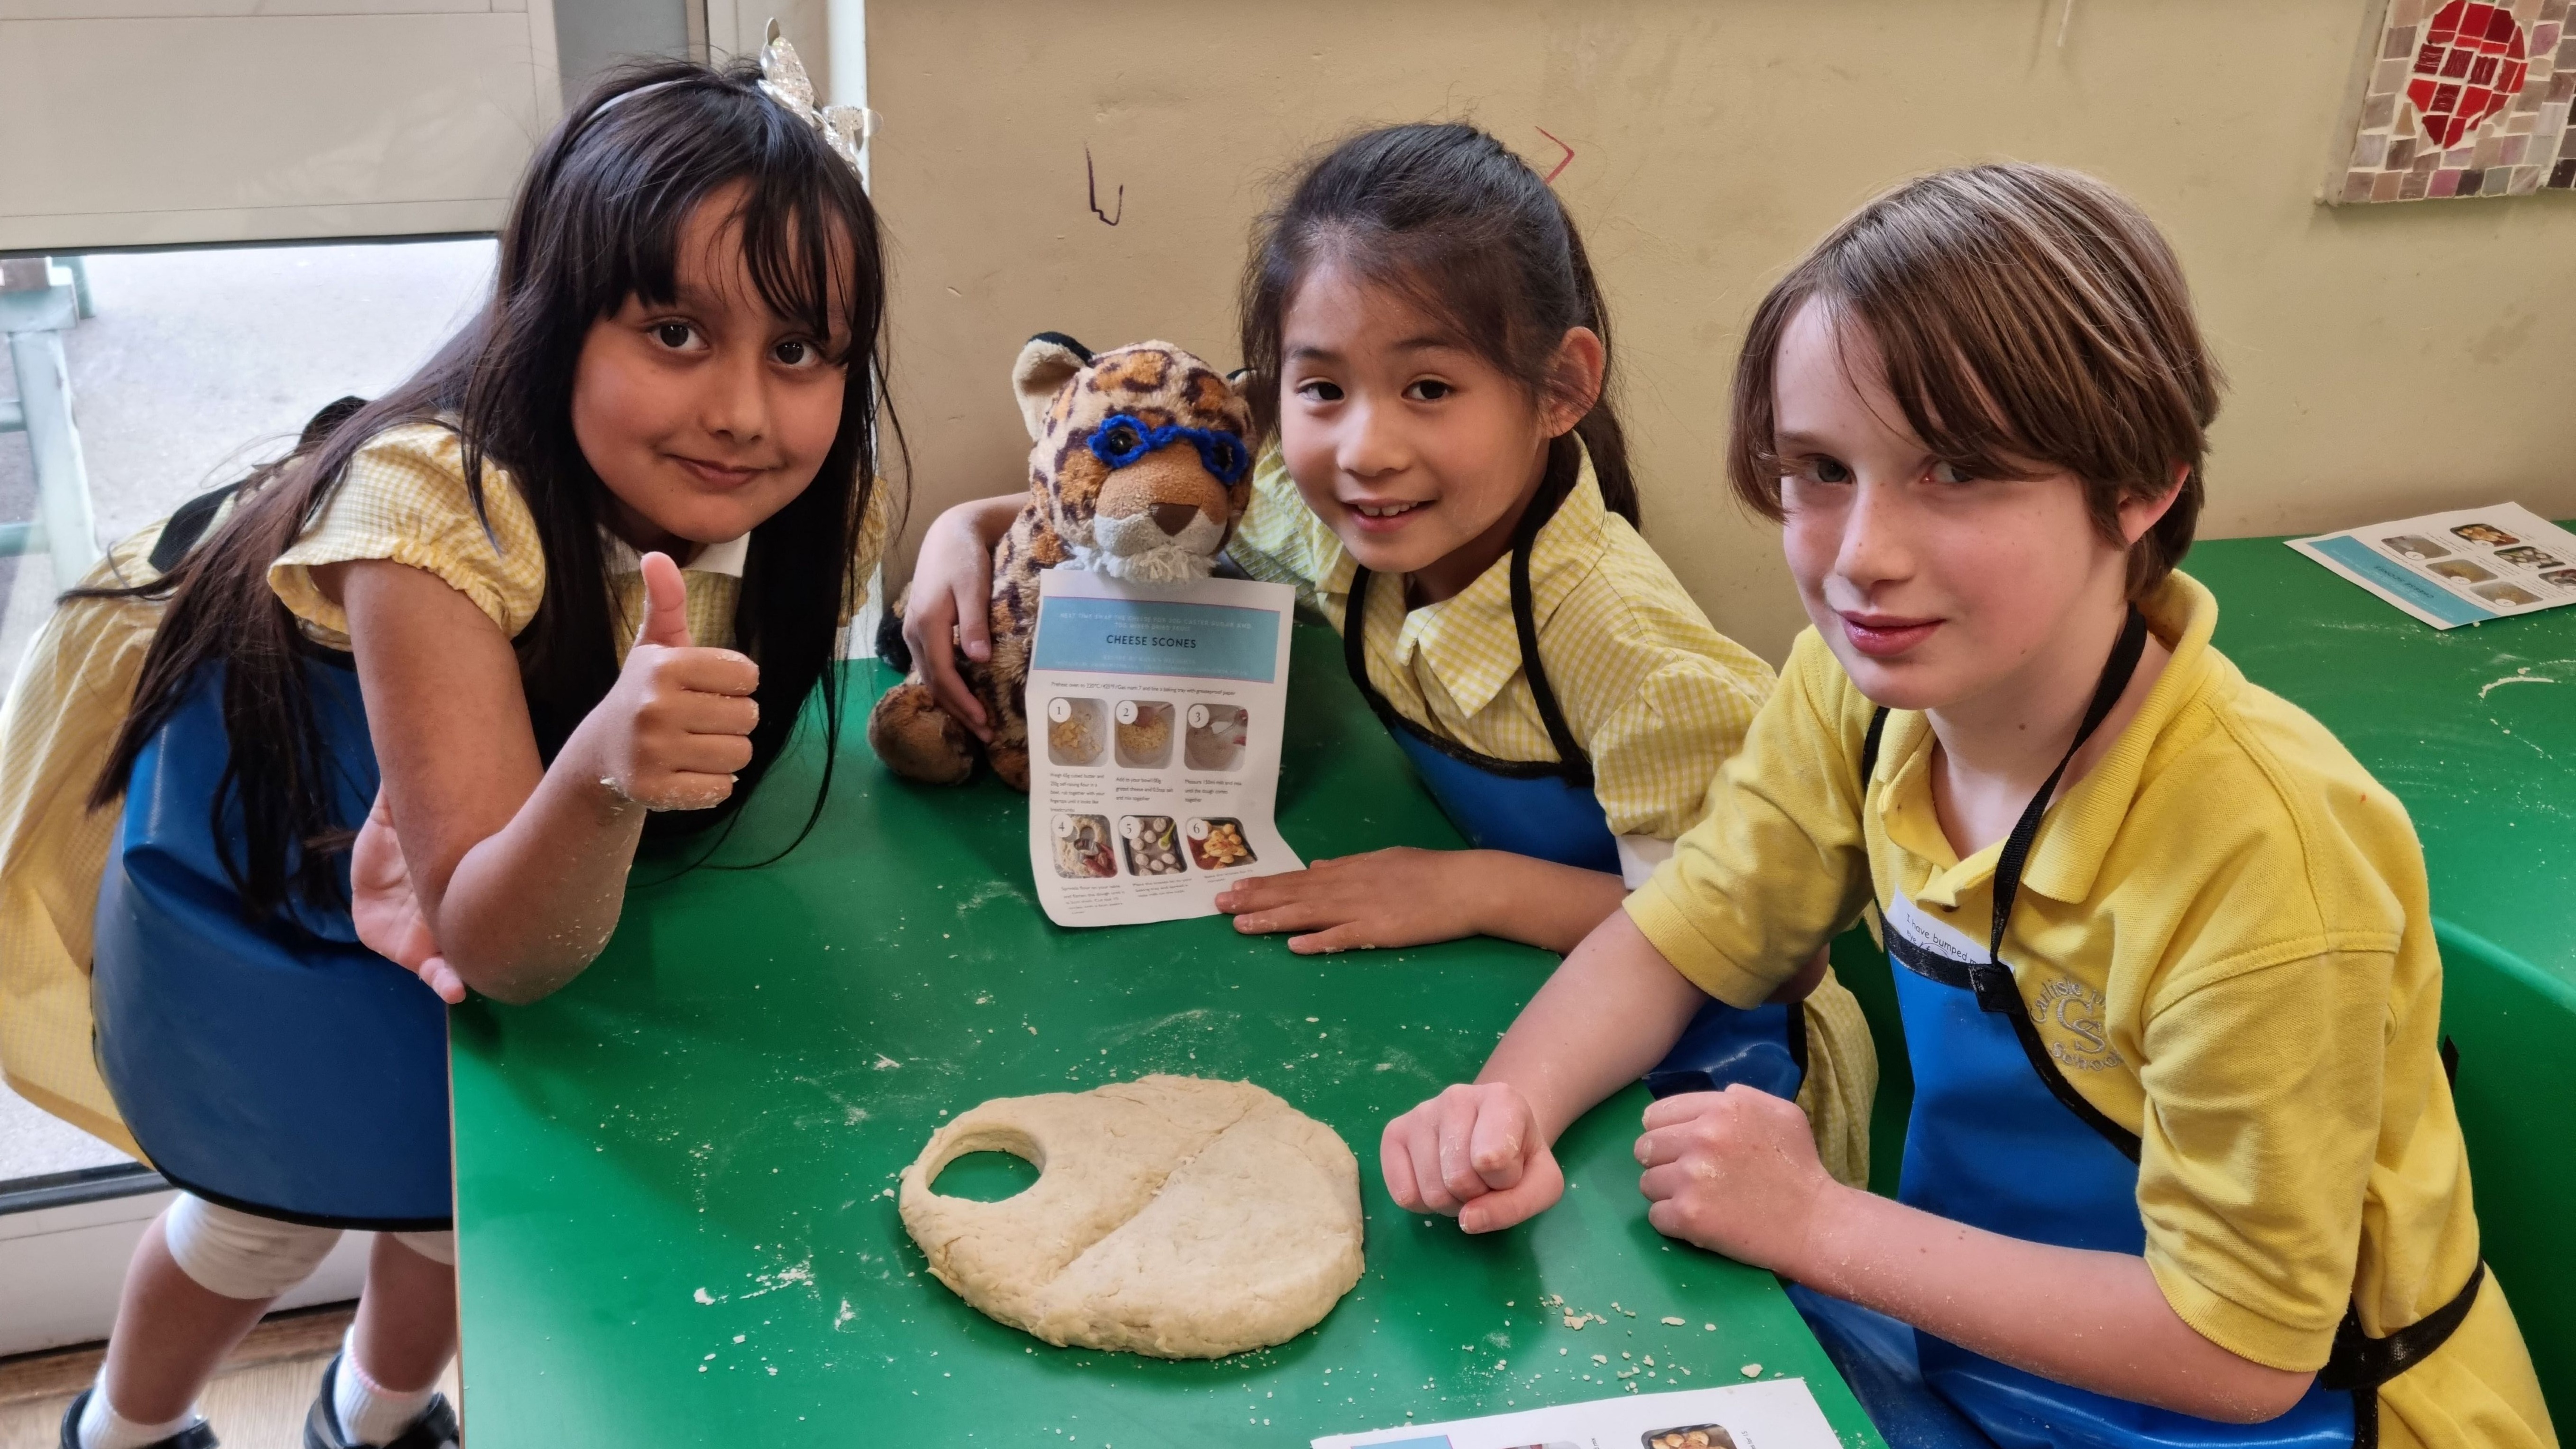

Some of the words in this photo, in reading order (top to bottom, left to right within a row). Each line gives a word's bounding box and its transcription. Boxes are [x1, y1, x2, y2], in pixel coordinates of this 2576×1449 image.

[1106, 635, 1147, 646] CHEESE
[1152, 637, 1197, 648] SCONES
[1057, 707, 1062, 715] 1
[1123, 708, 1129, 717] 2
[1195, 712, 1201, 723] 3
[1058, 821, 1065, 832] 4
[1126, 823, 1132, 834] 5
[1193, 823, 1200, 834] 6
[1907, 914, 1911, 923] I
[1912, 919, 1930, 939] have
[1933, 933, 1968, 961] bumped
[2031, 977, 2082, 1022] Carlisle
